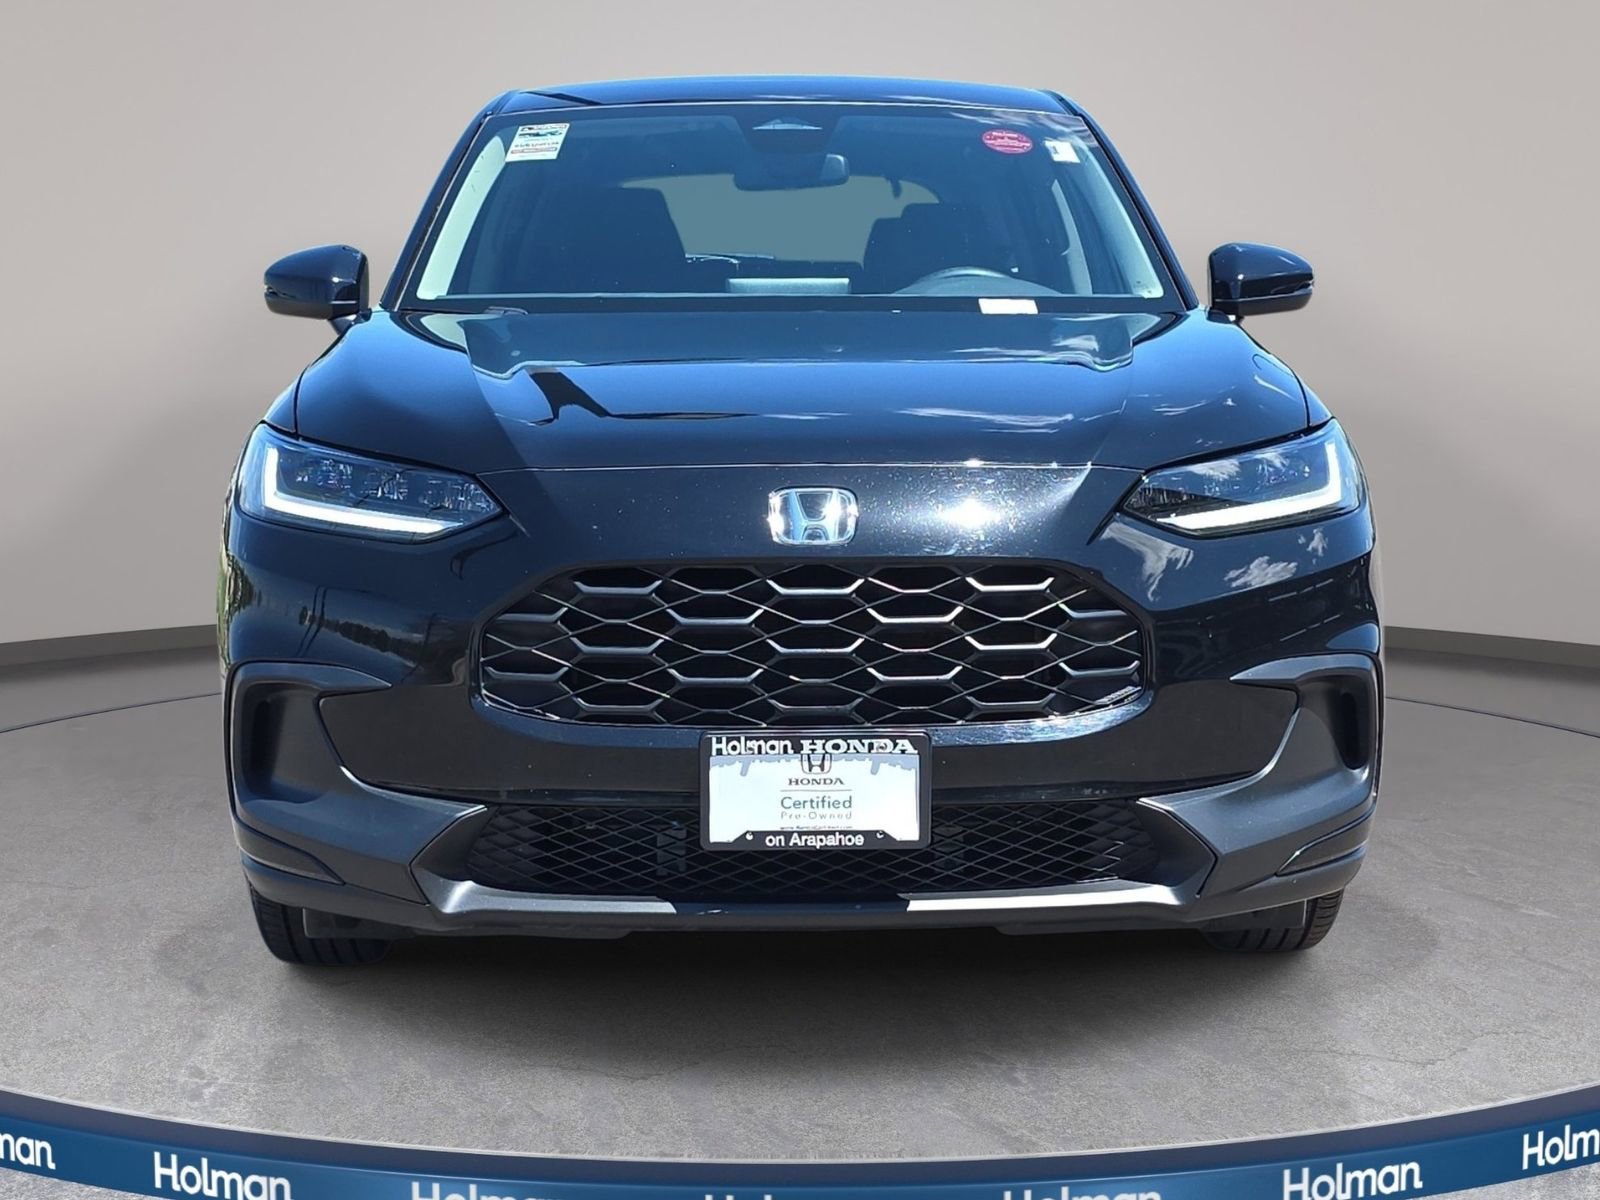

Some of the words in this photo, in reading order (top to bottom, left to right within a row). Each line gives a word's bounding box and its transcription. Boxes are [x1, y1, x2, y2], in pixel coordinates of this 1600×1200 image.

[711, 736, 794, 755] Holman
[800, 739, 918, 754] HONDA
[788, 777, 844, 785] HONDA
[780, 795, 852, 809] Certified
[765, 834, 785, 846] on
[789, 832, 864, 848] Arapahoe
